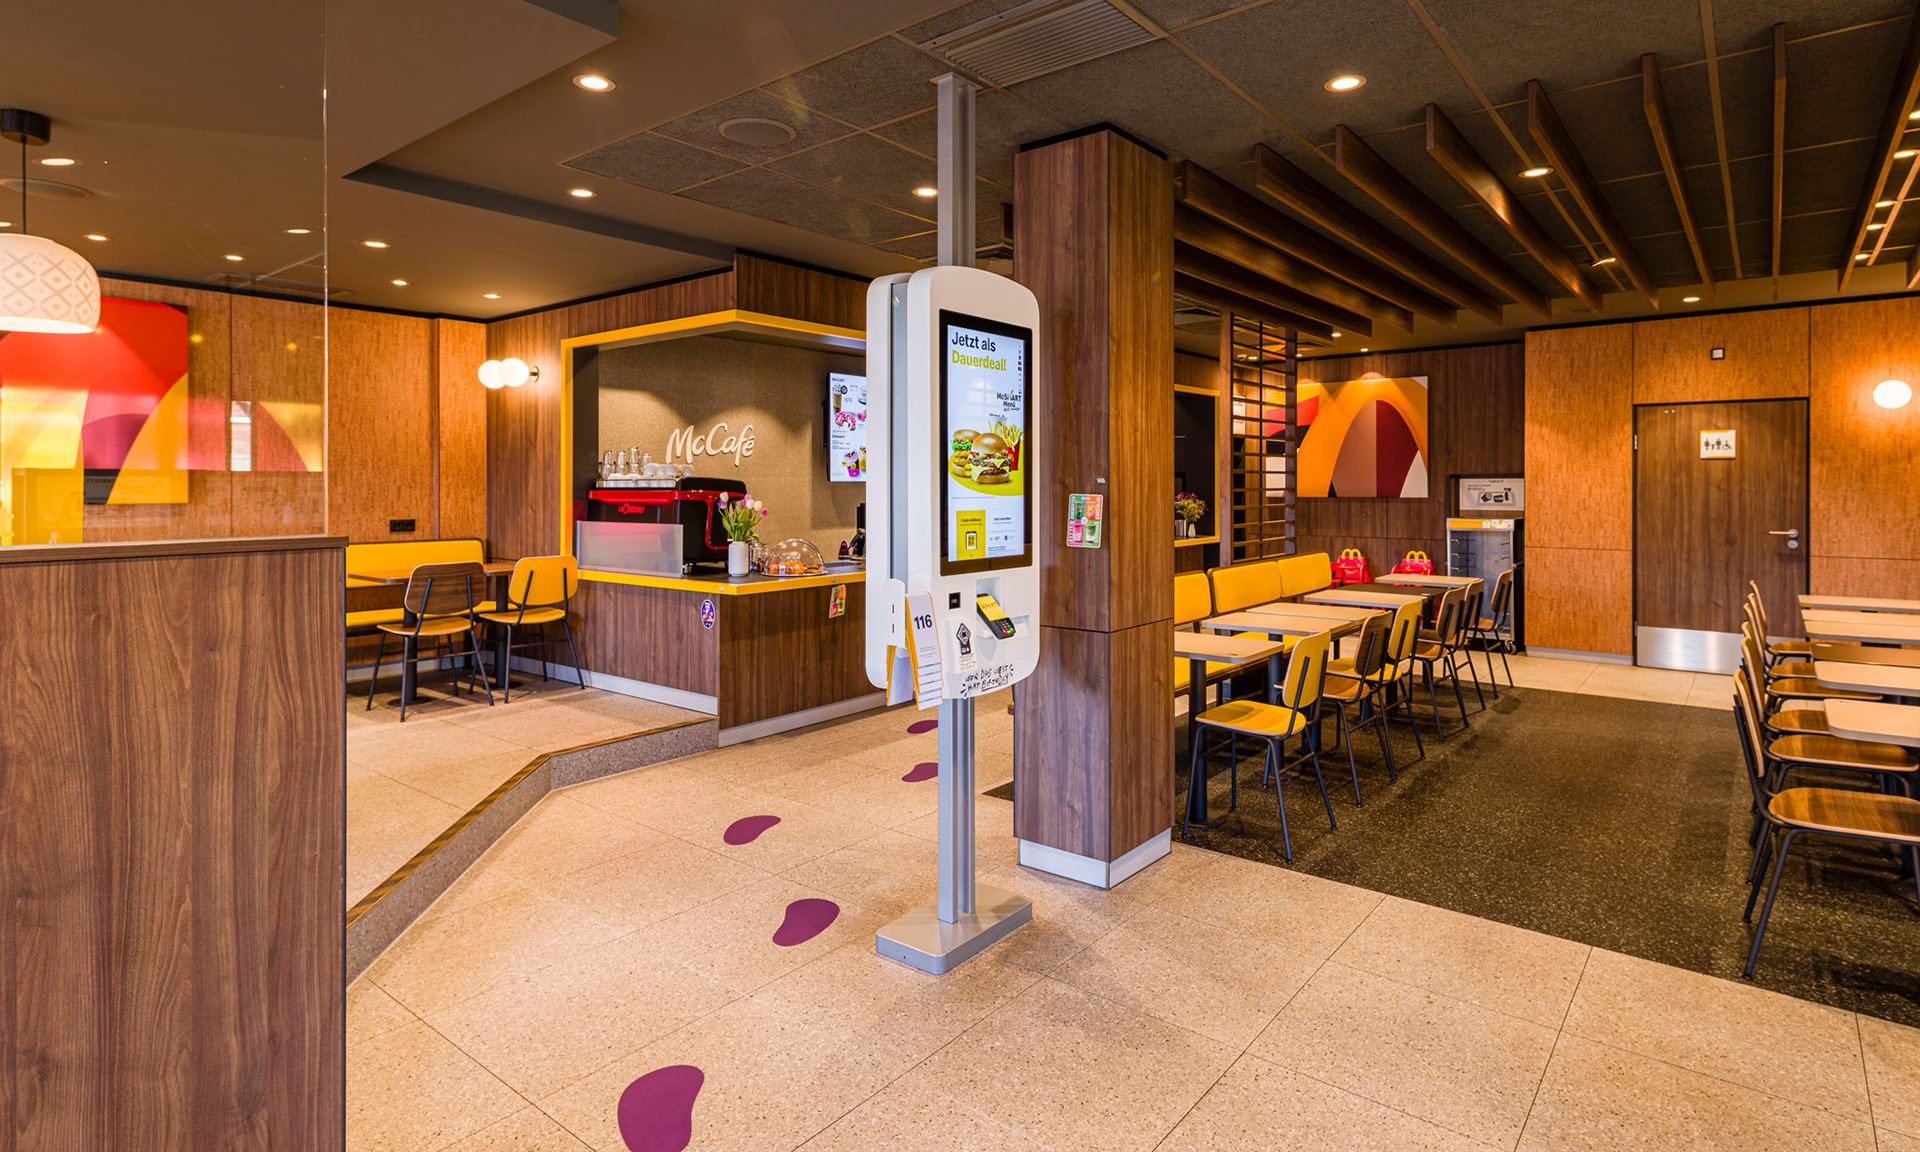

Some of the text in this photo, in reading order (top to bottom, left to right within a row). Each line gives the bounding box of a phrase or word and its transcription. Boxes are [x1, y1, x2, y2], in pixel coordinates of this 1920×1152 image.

[952, 332, 996, 352] Jetzt als
[952, 350, 1006, 371] Dauerdeal!
[666, 423, 755, 467] McCafé
[914, 614, 933, 630] 116
[981, 669, 992, 680] DAS
[968, 682, 980, 692] HAT
